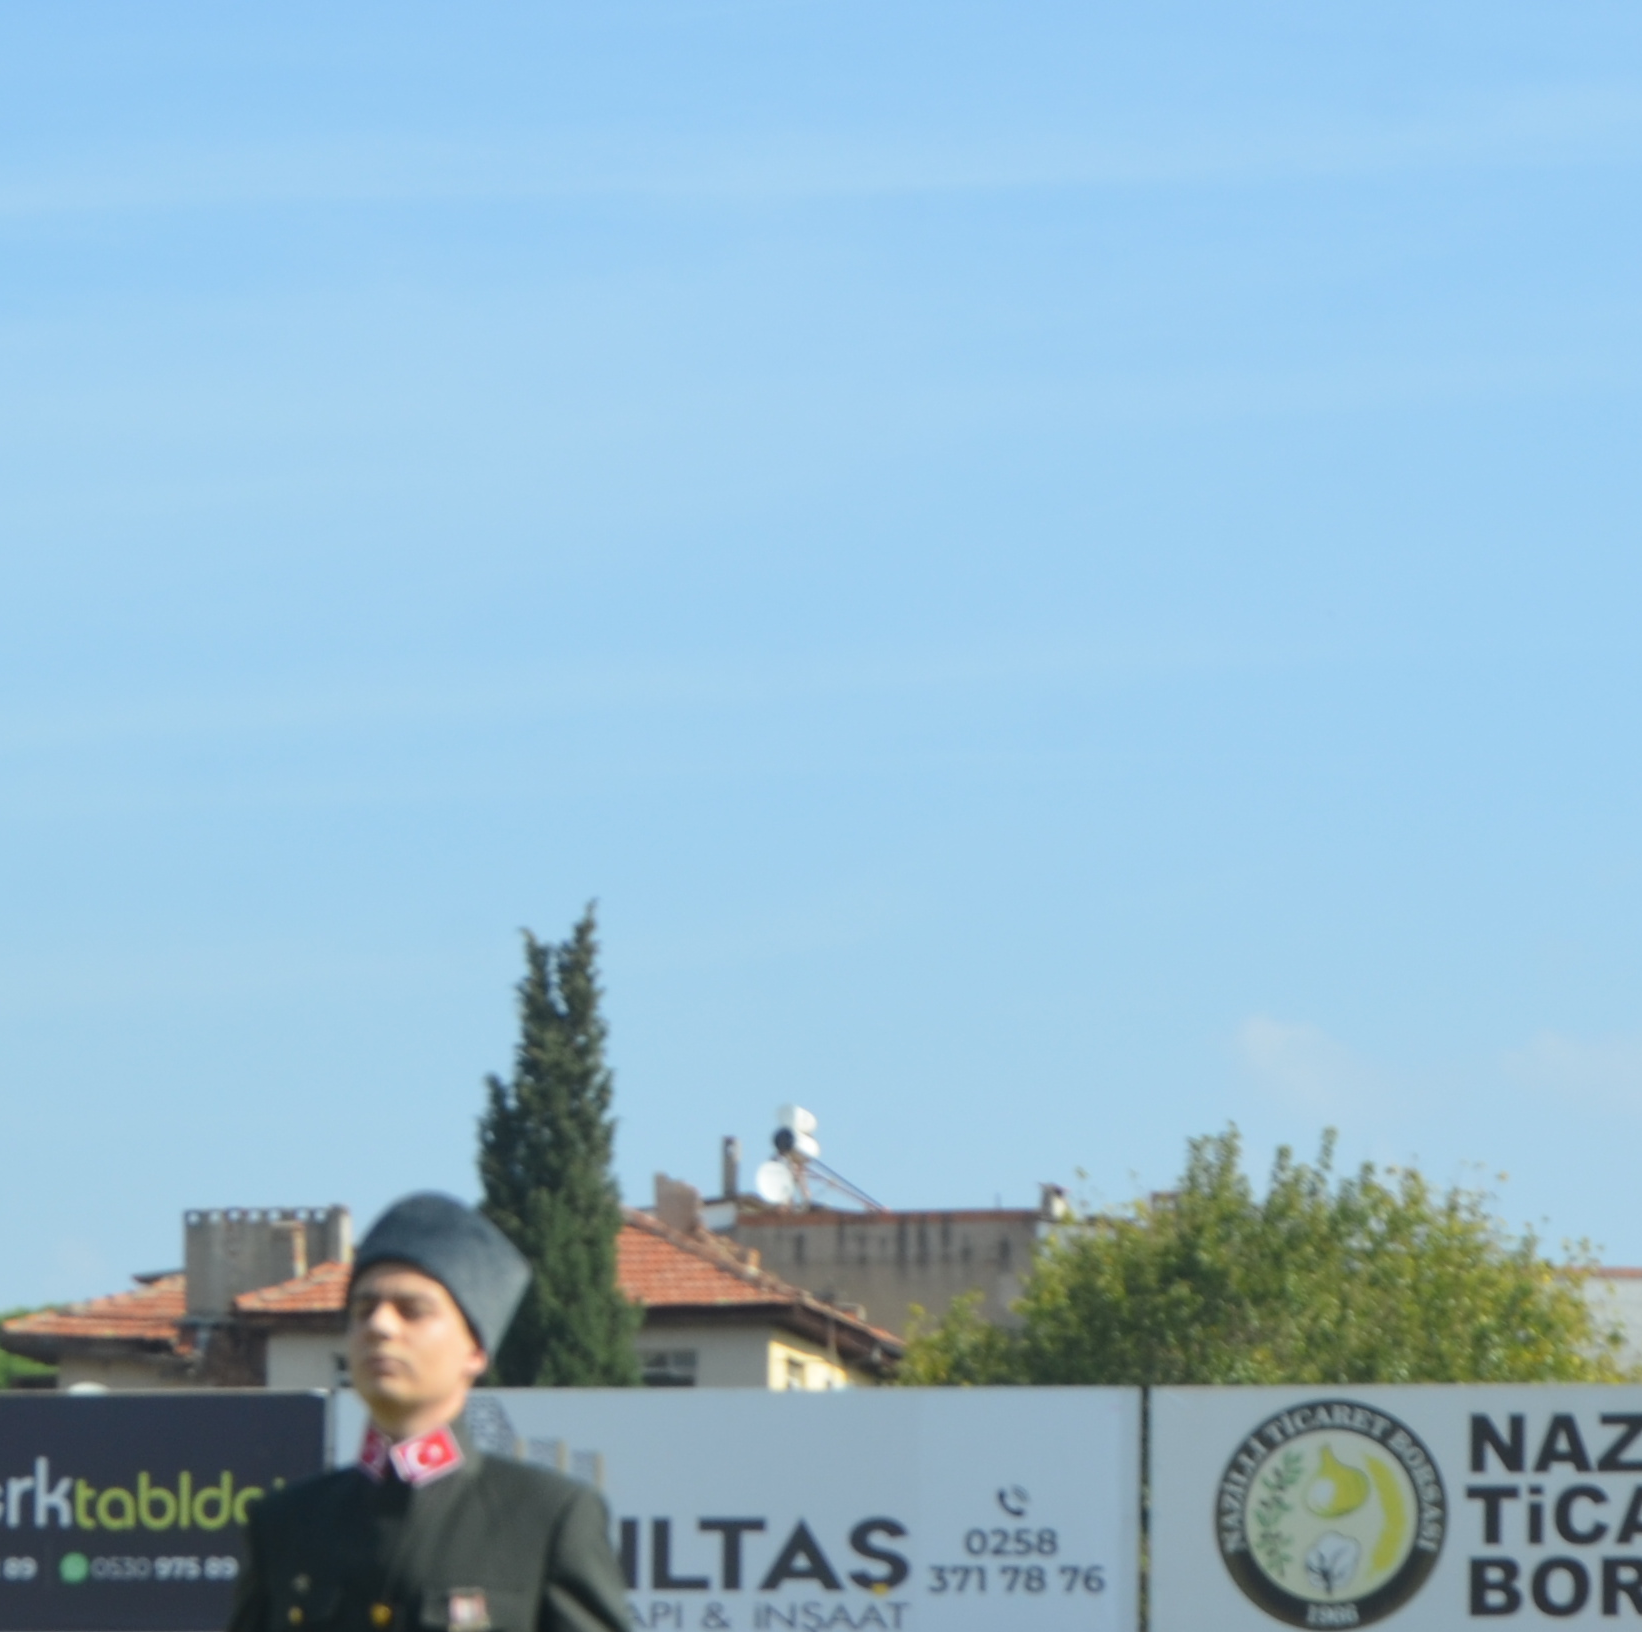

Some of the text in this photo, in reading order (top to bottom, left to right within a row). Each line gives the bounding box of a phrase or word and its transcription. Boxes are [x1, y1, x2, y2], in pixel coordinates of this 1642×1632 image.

[964, 1527, 1059, 1558] 0258
[3, 1556, 39, 1581] 89
[90, 1556, 152, 1581] 0530
[204, 1556, 240, 1581] 89
[928, 1564, 1107, 1594] 371 78 76
[702, 1601, 731, 1631] &
